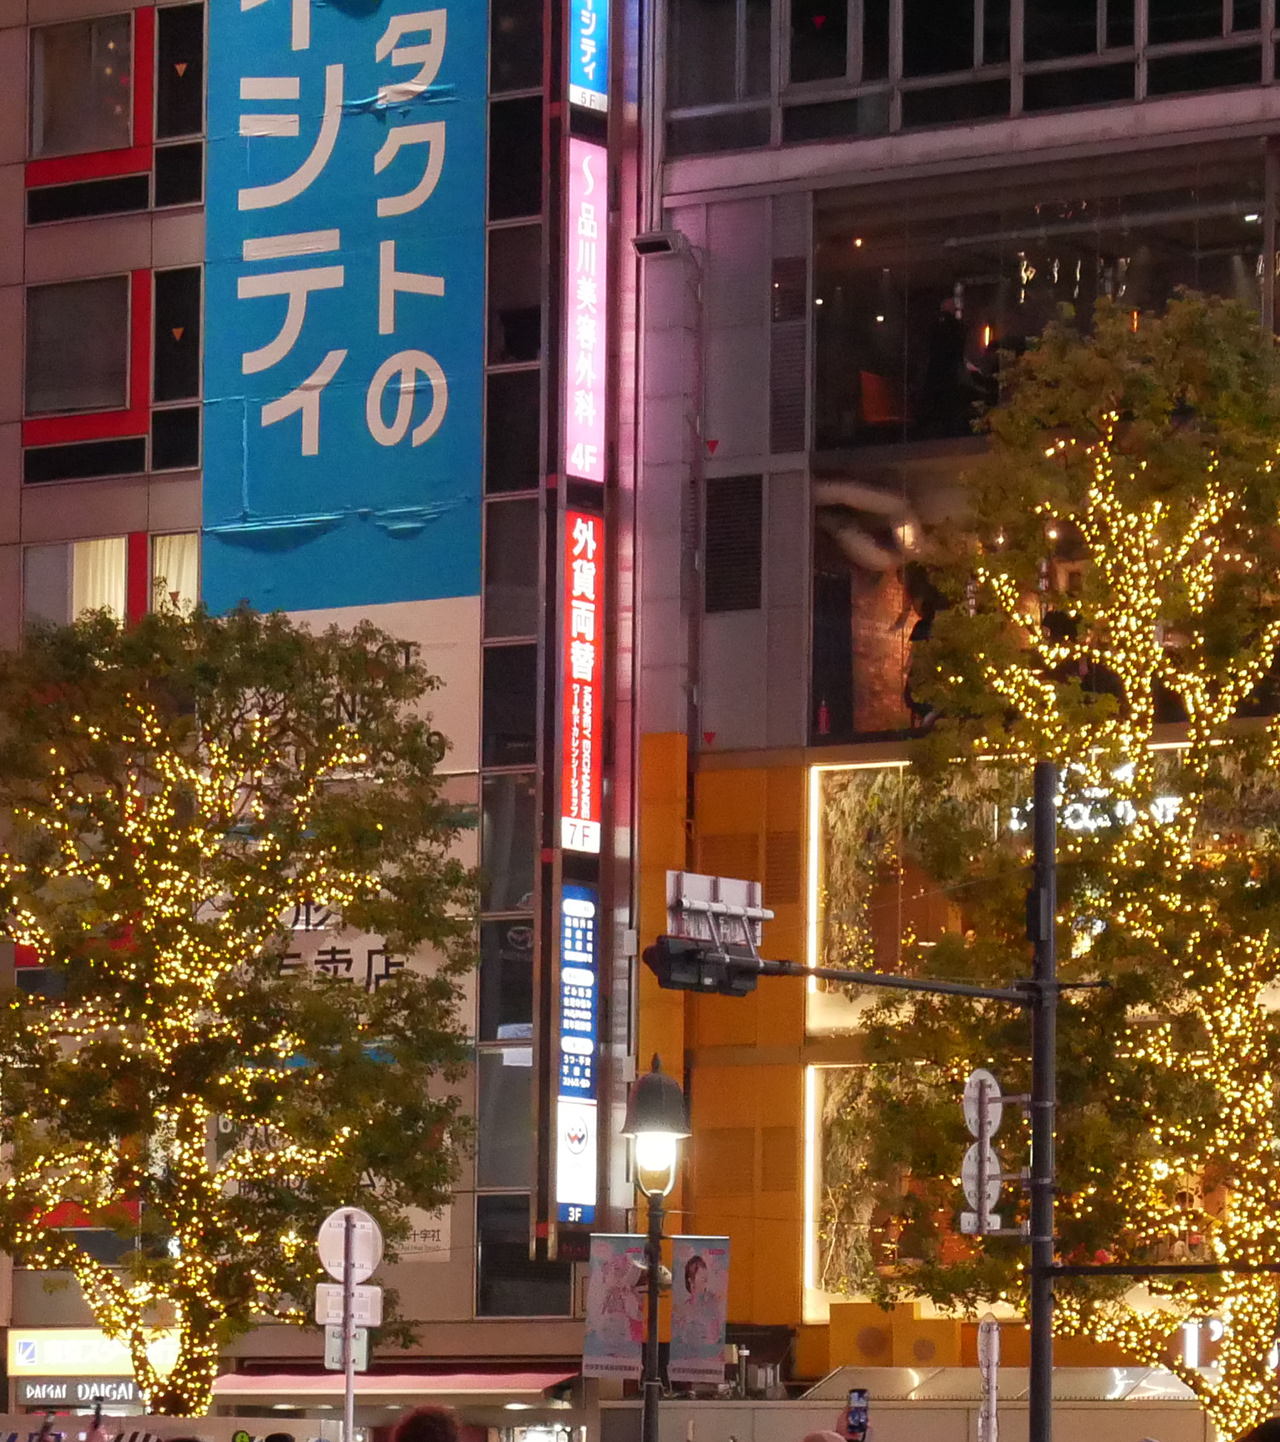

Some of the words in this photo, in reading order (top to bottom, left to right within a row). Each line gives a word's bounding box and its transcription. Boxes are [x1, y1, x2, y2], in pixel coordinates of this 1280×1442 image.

[580, 0, 596, 80] シティ
[580, 92, 596, 107] 5F
[366, 8, 449, 448] タクトの
[575, 203, 597, 427] 品川美容外科
[571, 443, 597, 472] 4F
[571, 518, 596, 682] 外貨両替
[582, 686, 592, 738] MONEY
[581, 739, 592, 820] EXCHANGE
[570, 823, 591, 846] 7F
[410, 1229, 441, 1243] 十字社
[568, 1206, 582, 1222] 3F
